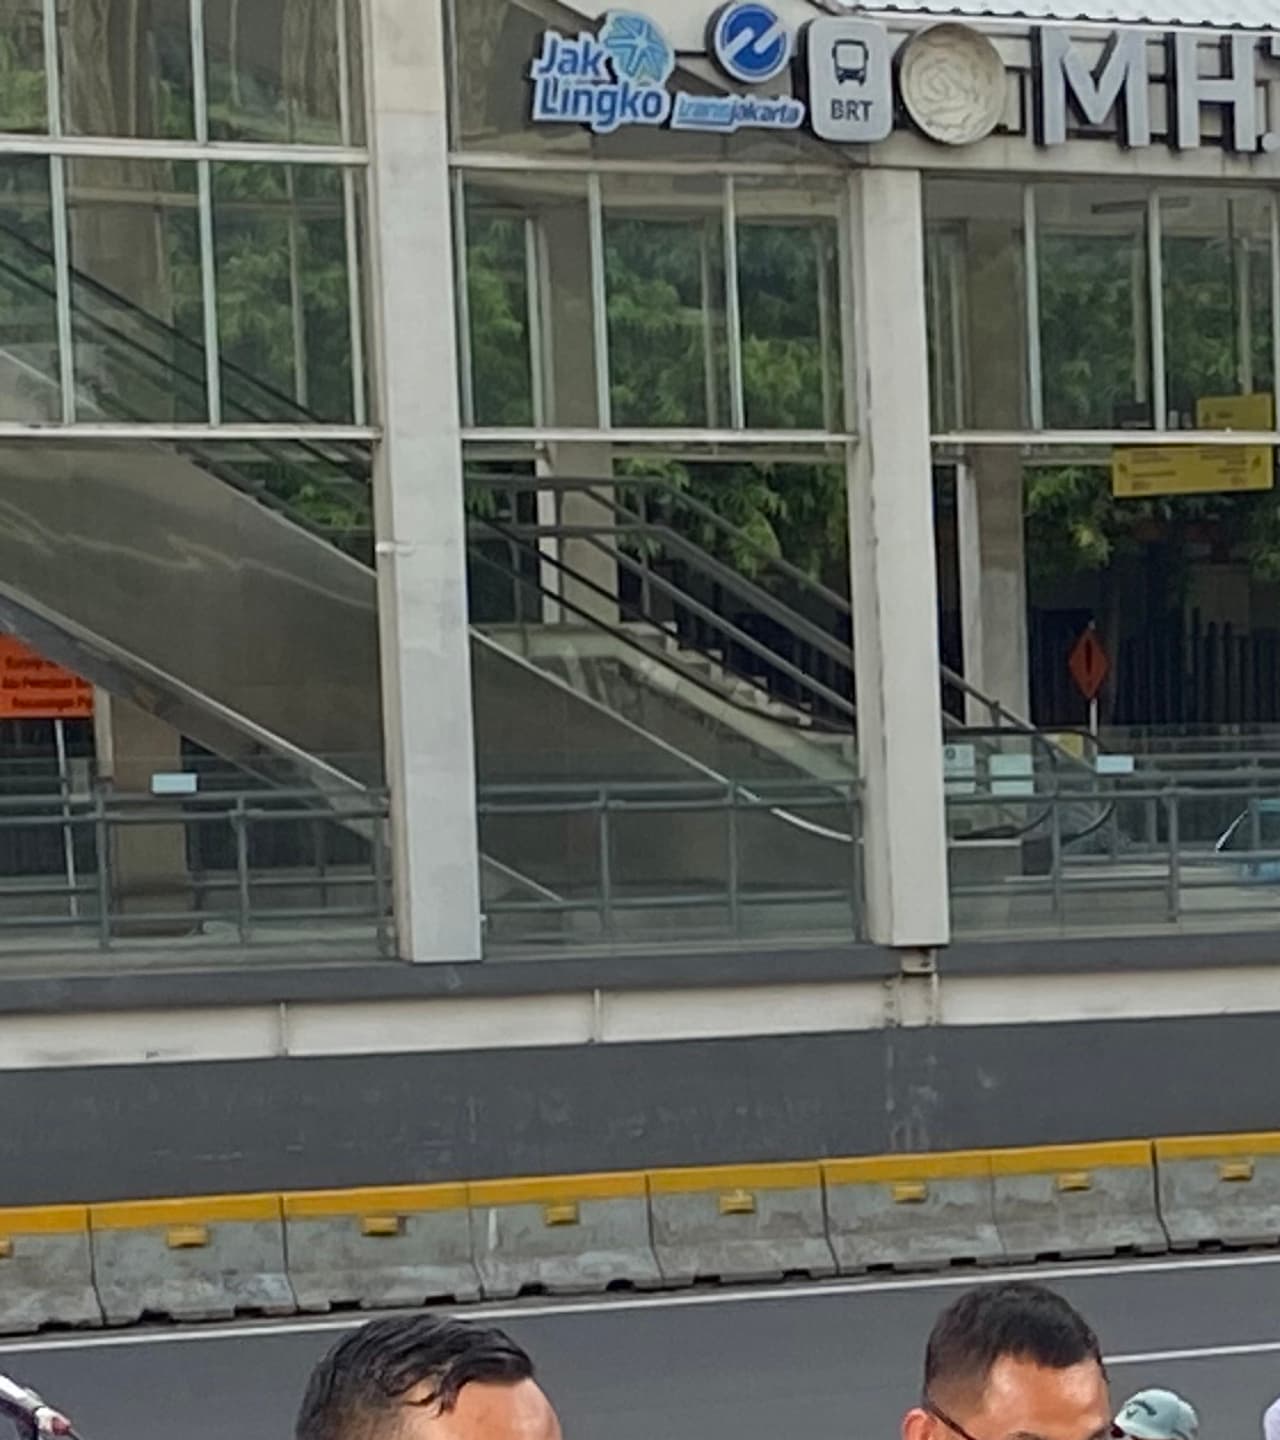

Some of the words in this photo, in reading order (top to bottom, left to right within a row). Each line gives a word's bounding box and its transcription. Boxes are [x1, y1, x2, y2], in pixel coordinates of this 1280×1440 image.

[538, 38, 603, 75] Jak
[540, 79, 663, 126] Lingko
[831, 99, 873, 121] BRT
